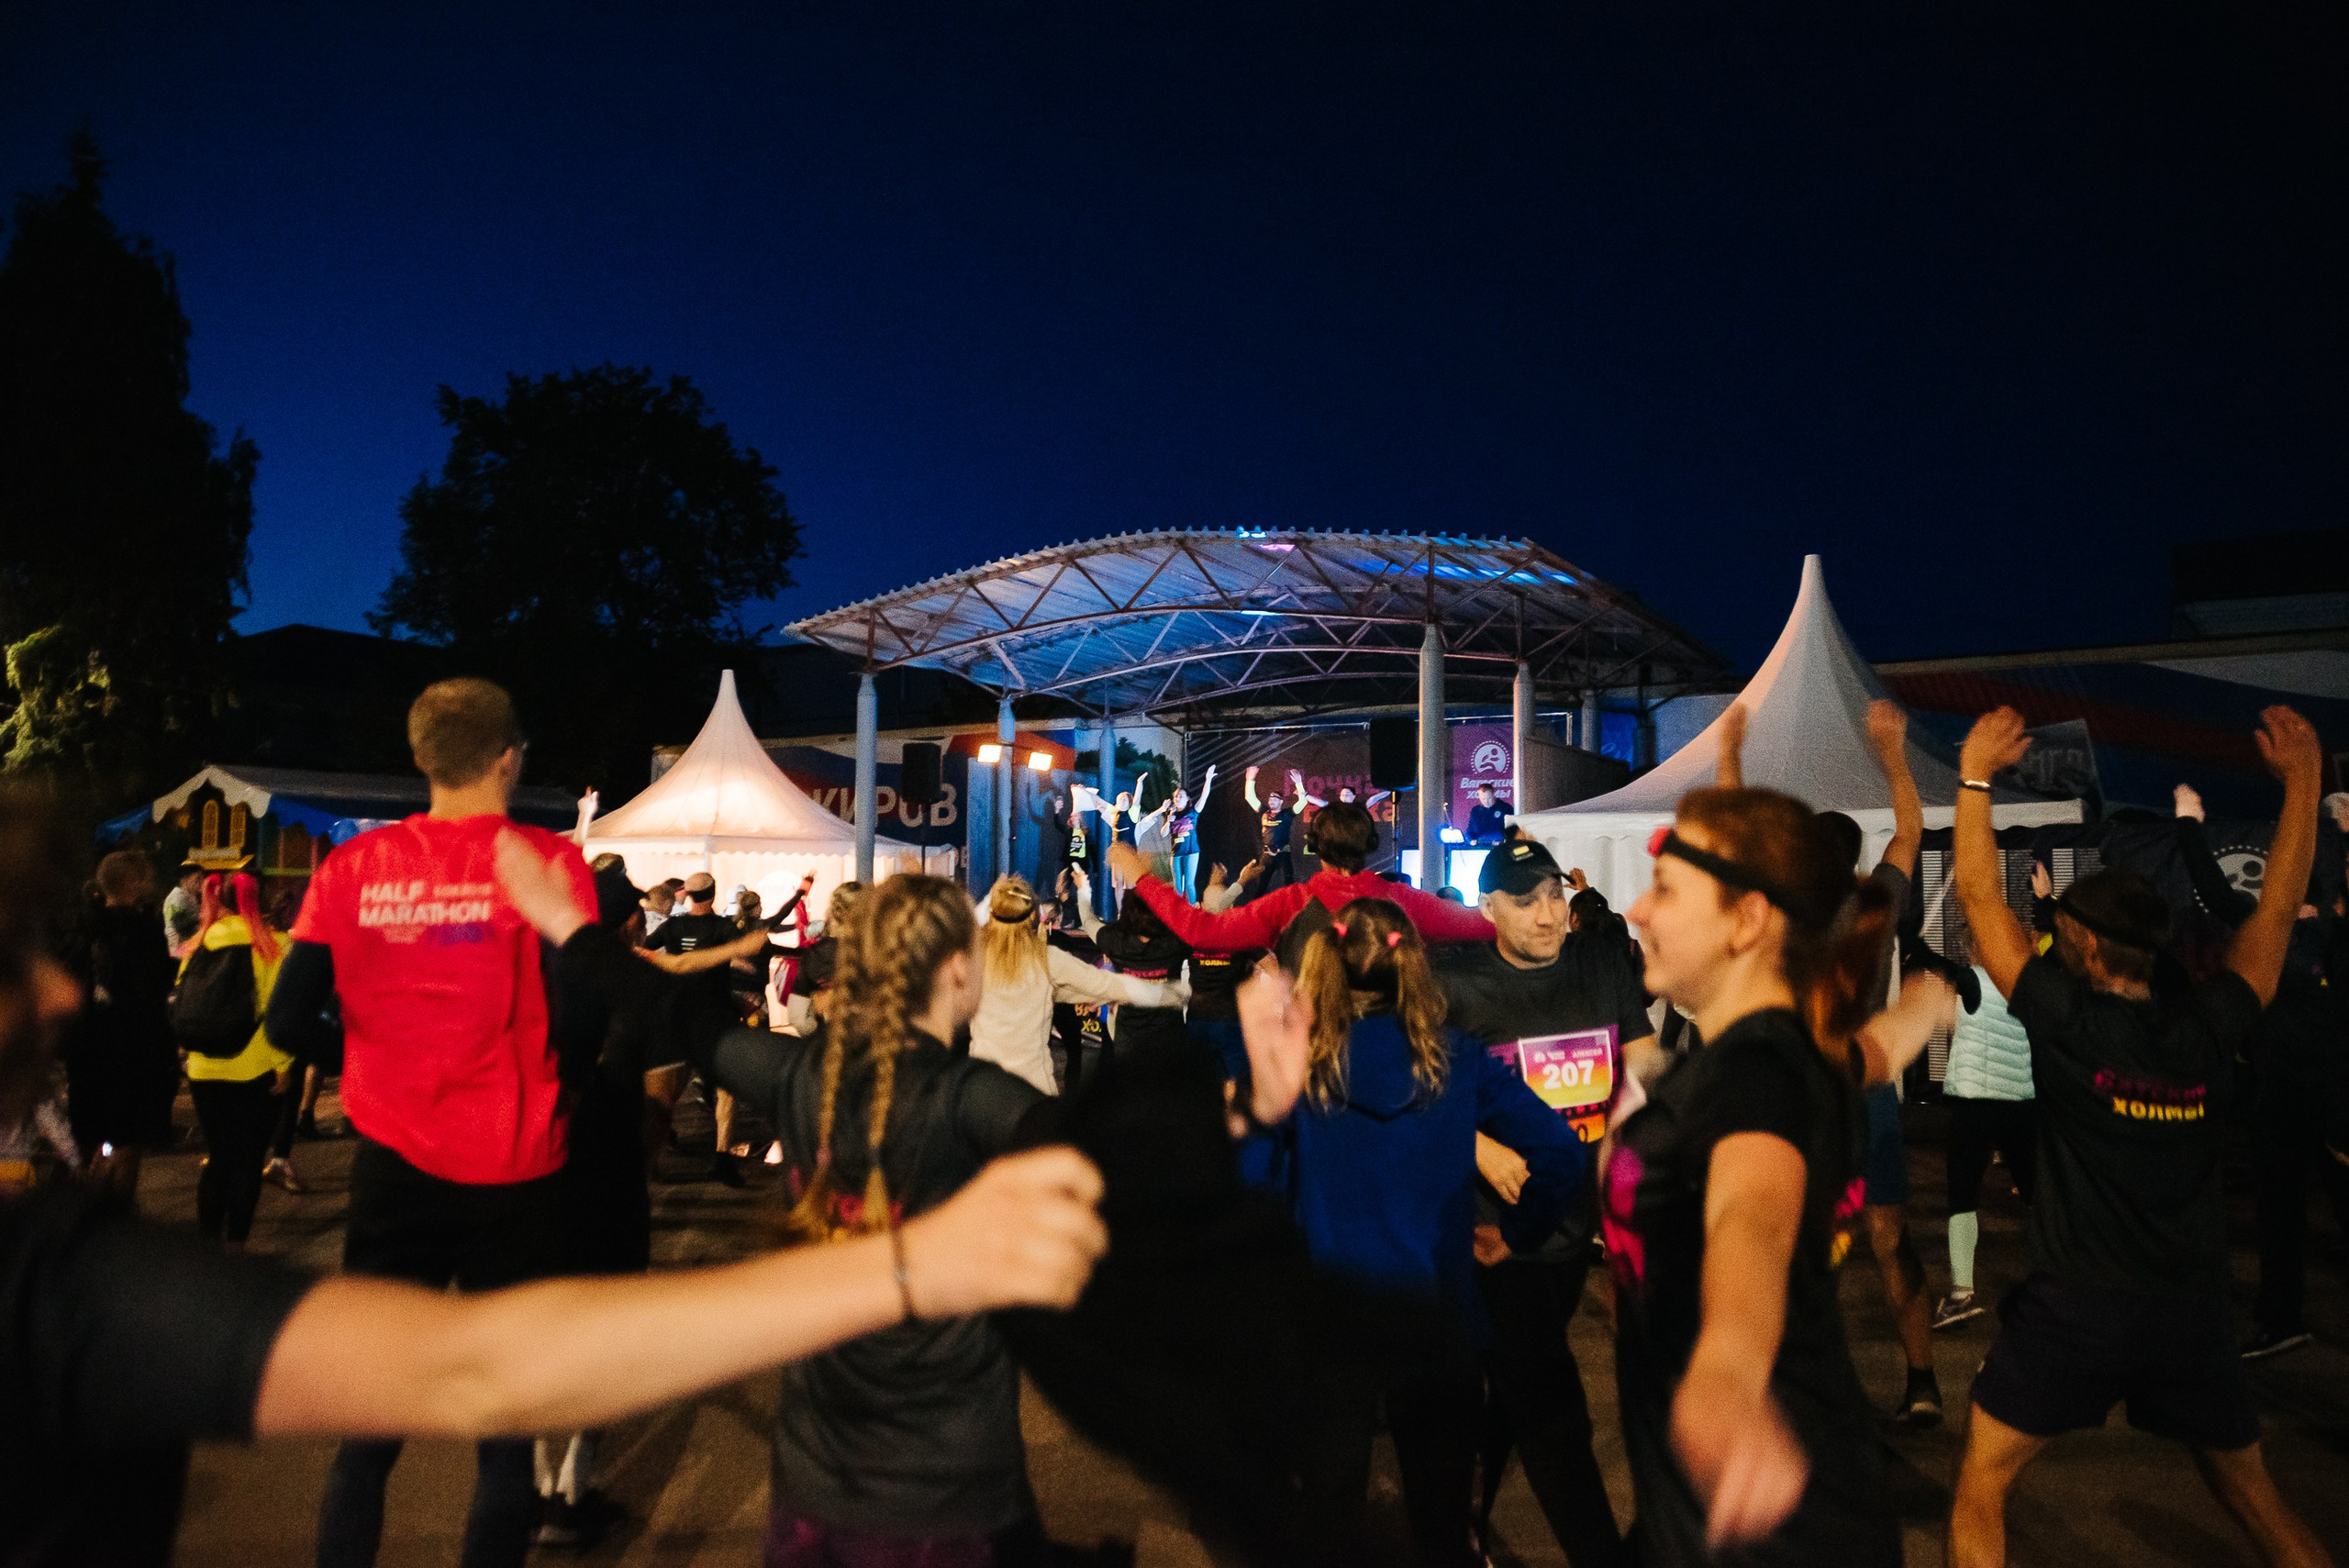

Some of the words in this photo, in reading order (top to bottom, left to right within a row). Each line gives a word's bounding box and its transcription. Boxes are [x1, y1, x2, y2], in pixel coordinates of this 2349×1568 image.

[360, 881, 425, 903] HALF
[359, 901, 491, 928] MARATHON
[1542, 1060, 1595, 1090] 207
[2112, 1097, 2205, 1121] холмы
